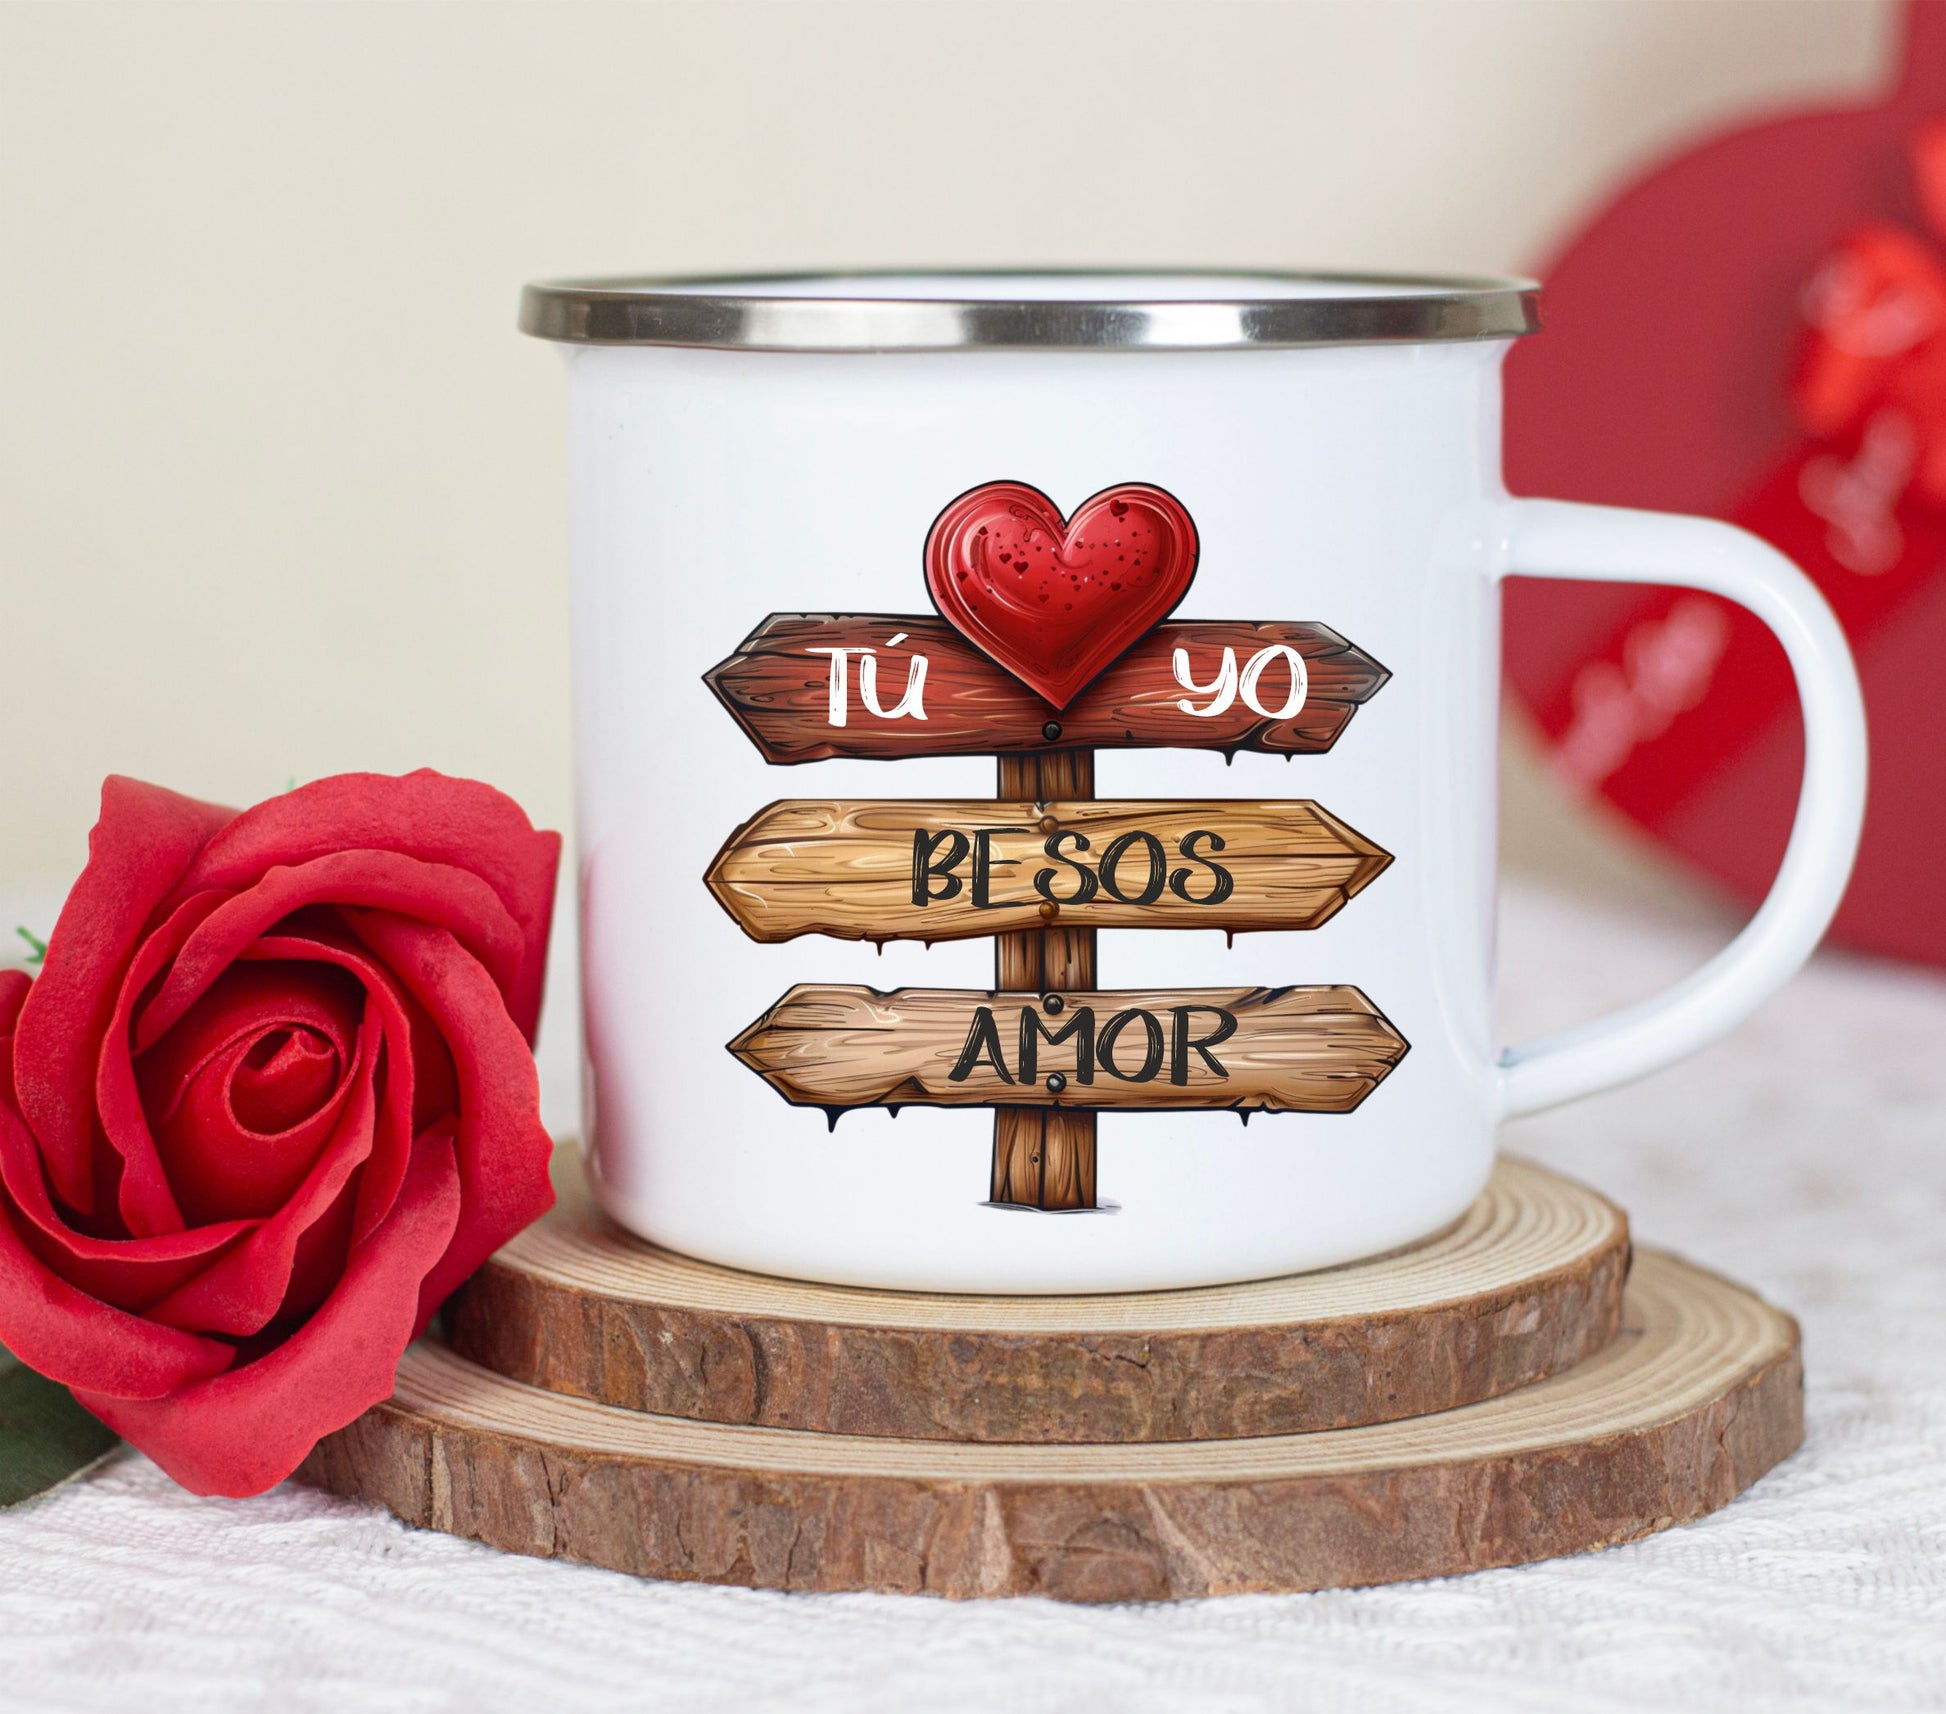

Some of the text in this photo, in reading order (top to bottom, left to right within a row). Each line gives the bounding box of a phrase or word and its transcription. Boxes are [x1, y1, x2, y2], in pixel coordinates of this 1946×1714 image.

[1172, 644, 1308, 720] YO
[911, 826, 1235, 908] BESOS
[947, 1005, 1239, 1087] AMOR
